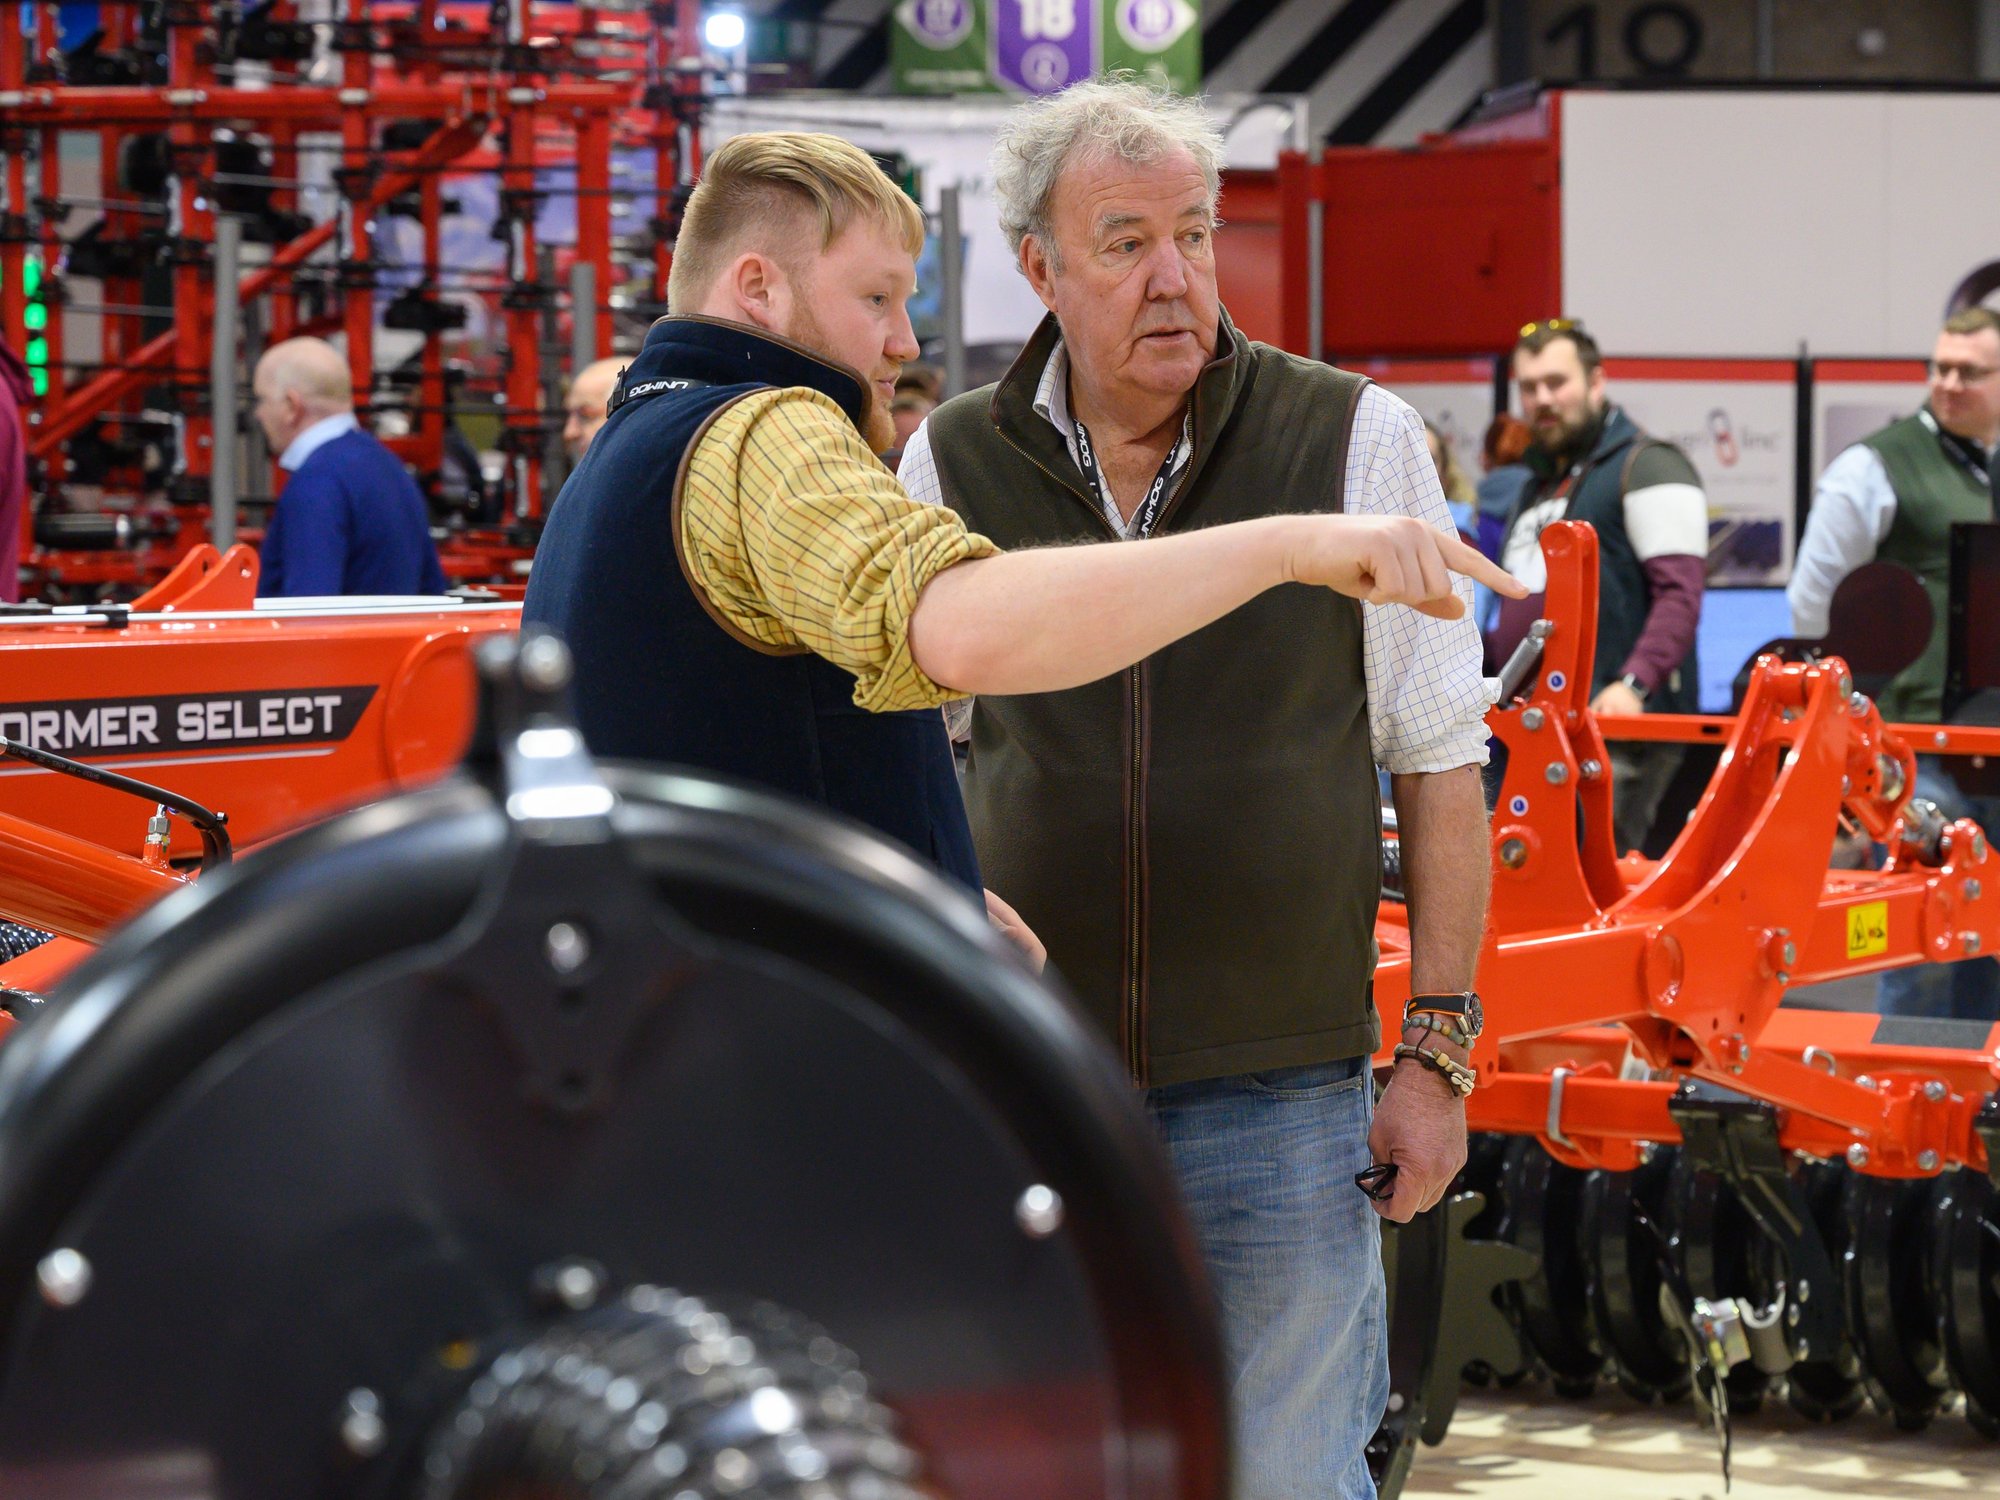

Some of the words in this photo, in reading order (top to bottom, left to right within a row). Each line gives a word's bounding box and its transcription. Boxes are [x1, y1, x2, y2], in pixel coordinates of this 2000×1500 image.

[1546, 3, 1704, 79] 10
[628, 380, 689, 398] UNIMOG
[1075, 420, 1092, 468] NIMOG
[176, 695, 342, 743] SELECT
